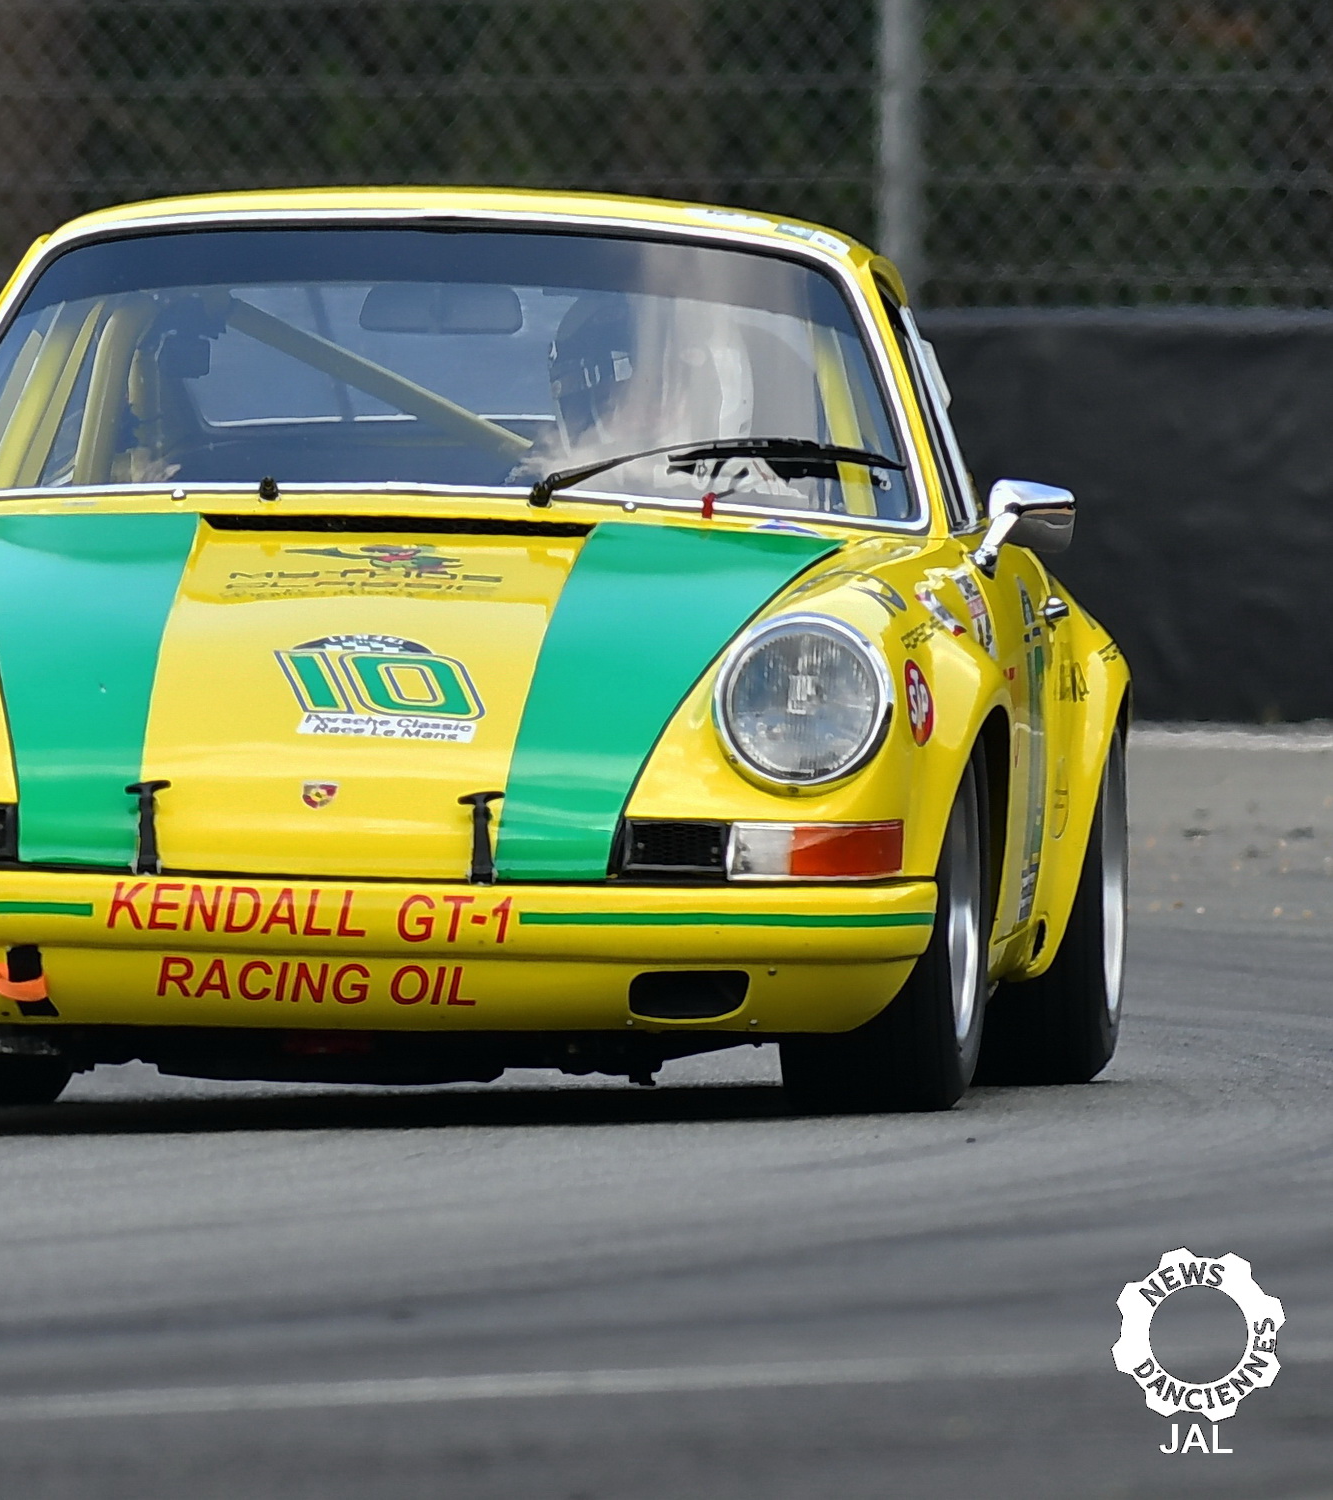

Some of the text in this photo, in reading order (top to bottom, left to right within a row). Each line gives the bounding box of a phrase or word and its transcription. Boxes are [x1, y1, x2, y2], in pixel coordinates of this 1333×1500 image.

[273, 650, 486, 720] 10
[304, 713, 472, 733] Porsche Classic
[313, 723, 459, 741] Race Le Mans
[107, 882, 513, 943] KENDALL GT-1
[156, 957, 477, 1006] RACING OIL
